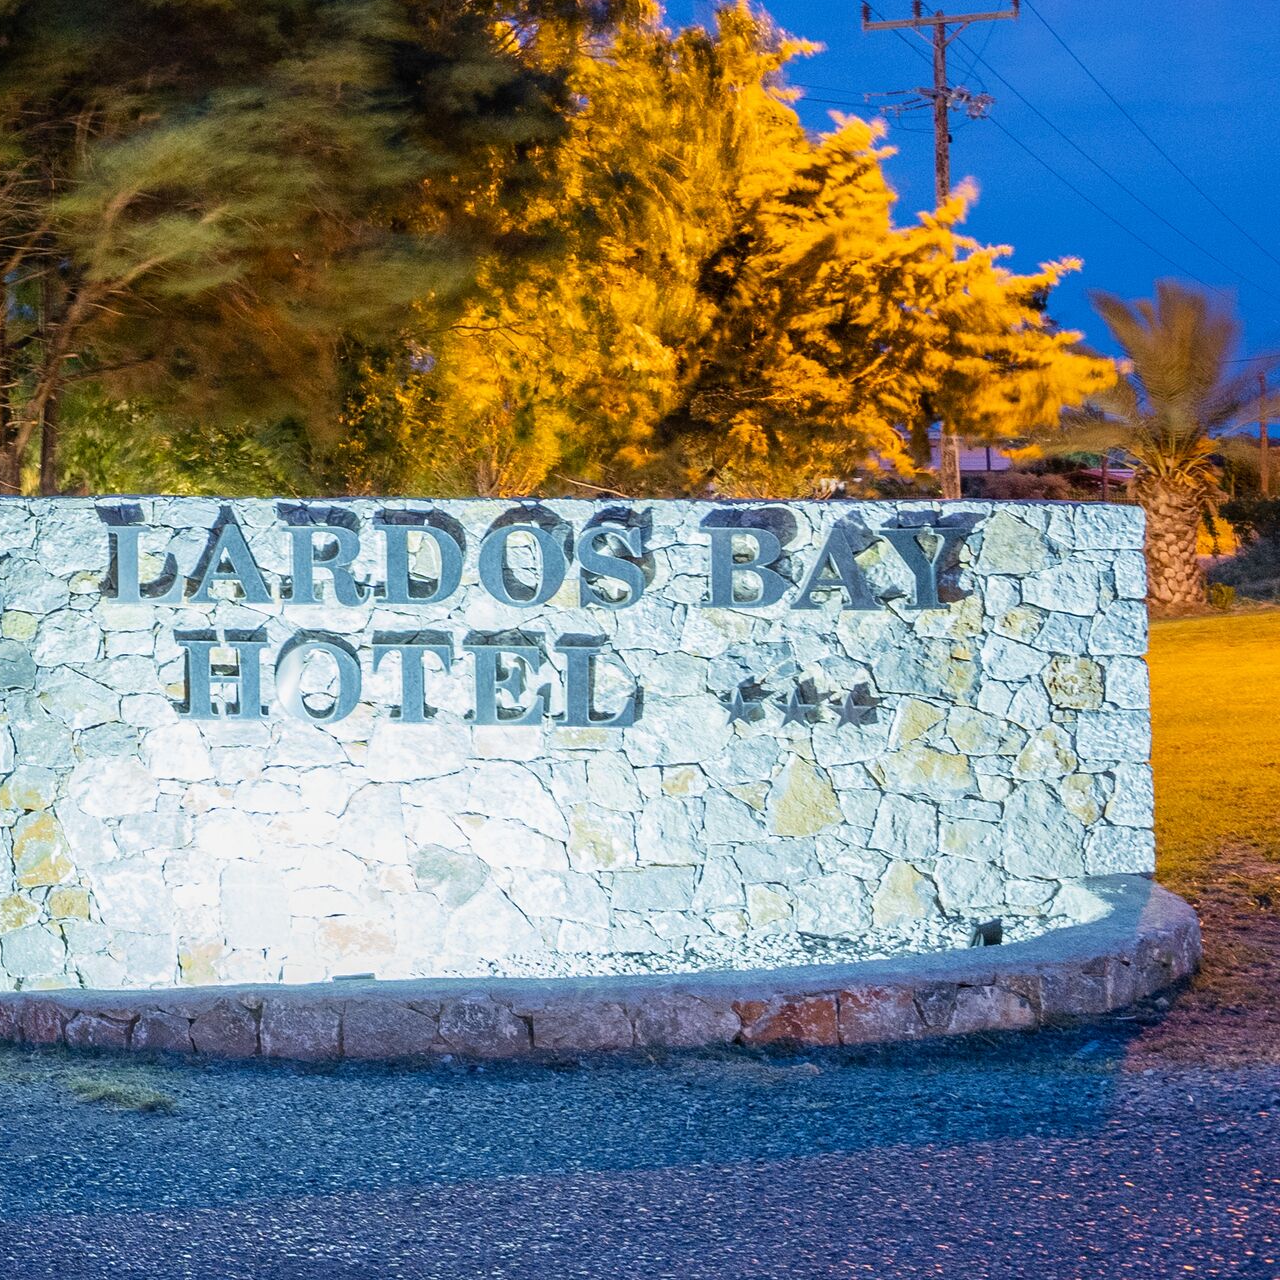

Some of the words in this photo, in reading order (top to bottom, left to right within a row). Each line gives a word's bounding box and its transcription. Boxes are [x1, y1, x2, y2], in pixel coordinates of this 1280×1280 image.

[107, 523, 645, 608] LARDOS
[699, 523, 970, 610] BAY
[177, 639, 639, 727] HOTEL
